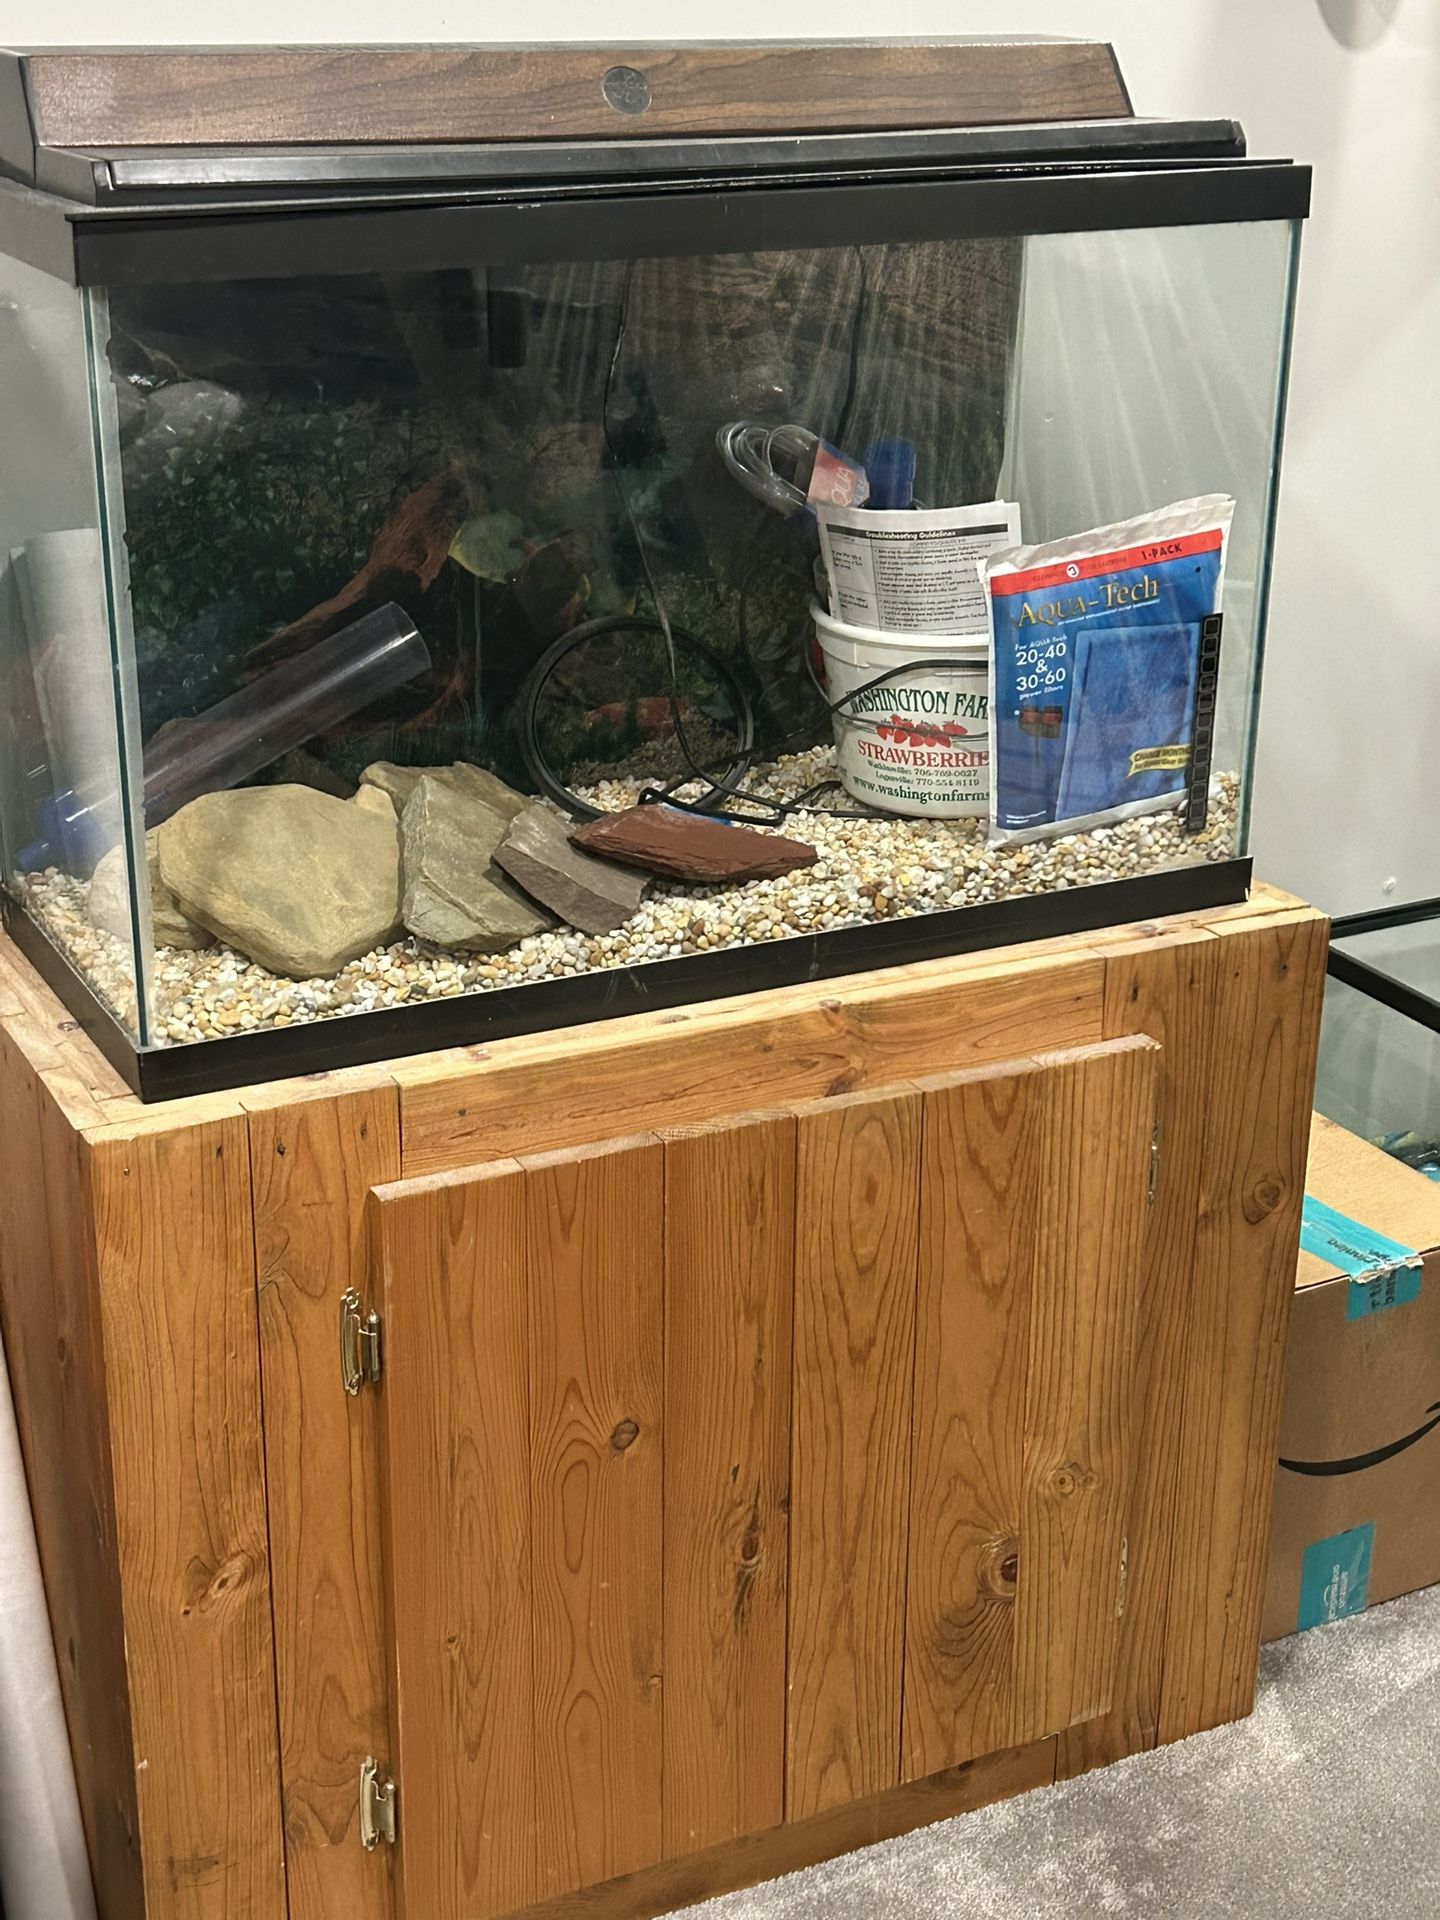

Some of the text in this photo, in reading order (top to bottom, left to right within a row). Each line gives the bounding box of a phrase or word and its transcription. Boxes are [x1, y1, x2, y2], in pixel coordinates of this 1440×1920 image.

[919, 528, 956, 539] Guidelines
[1141, 543, 1182, 560] 1-PACK
[1015, 642, 1067, 666] 20-40
[1035, 658, 1048, 674] &
[1015, 667, 1067, 691] 30-60
[845, 688, 949, 714] WASHINGTON
